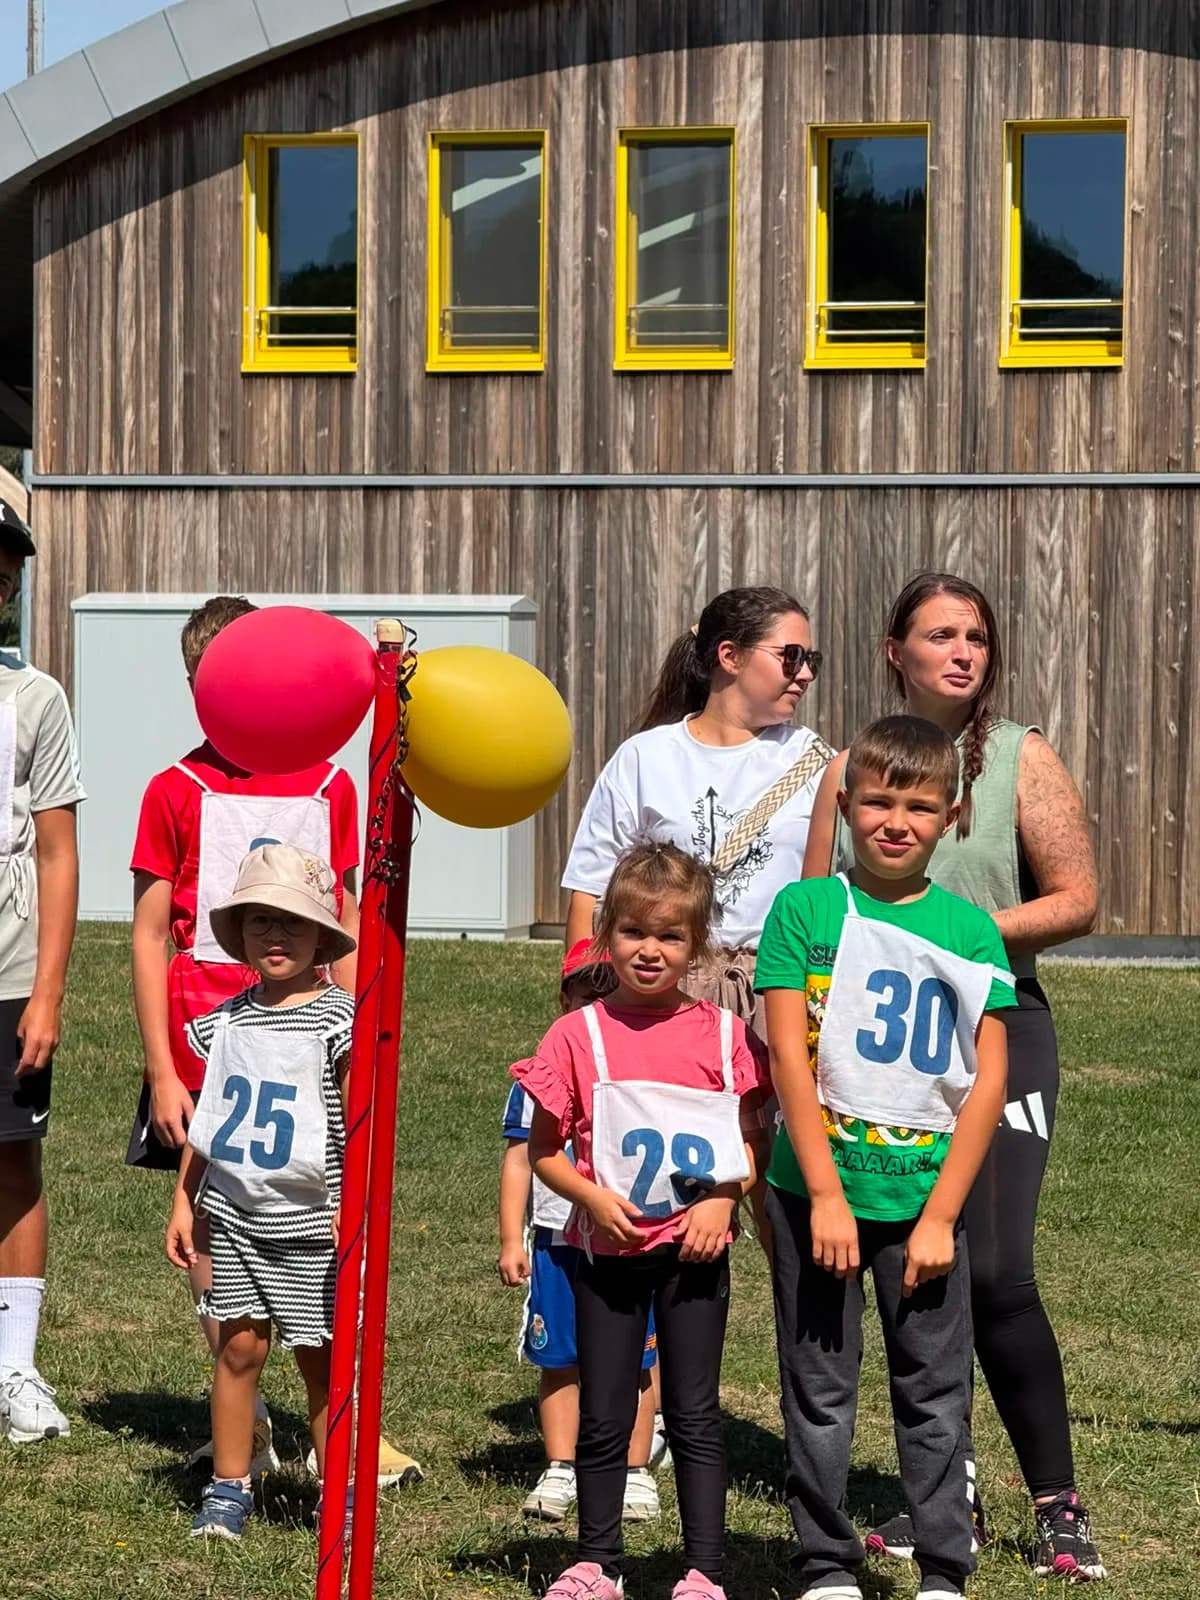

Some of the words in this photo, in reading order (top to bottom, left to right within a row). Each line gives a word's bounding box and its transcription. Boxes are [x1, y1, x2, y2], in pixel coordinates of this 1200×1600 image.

[691, 797, 710, 847] Together
[855, 968, 959, 1077] 30
[210, 1074, 299, 1171] 25
[621, 1127, 717, 1219] 28
